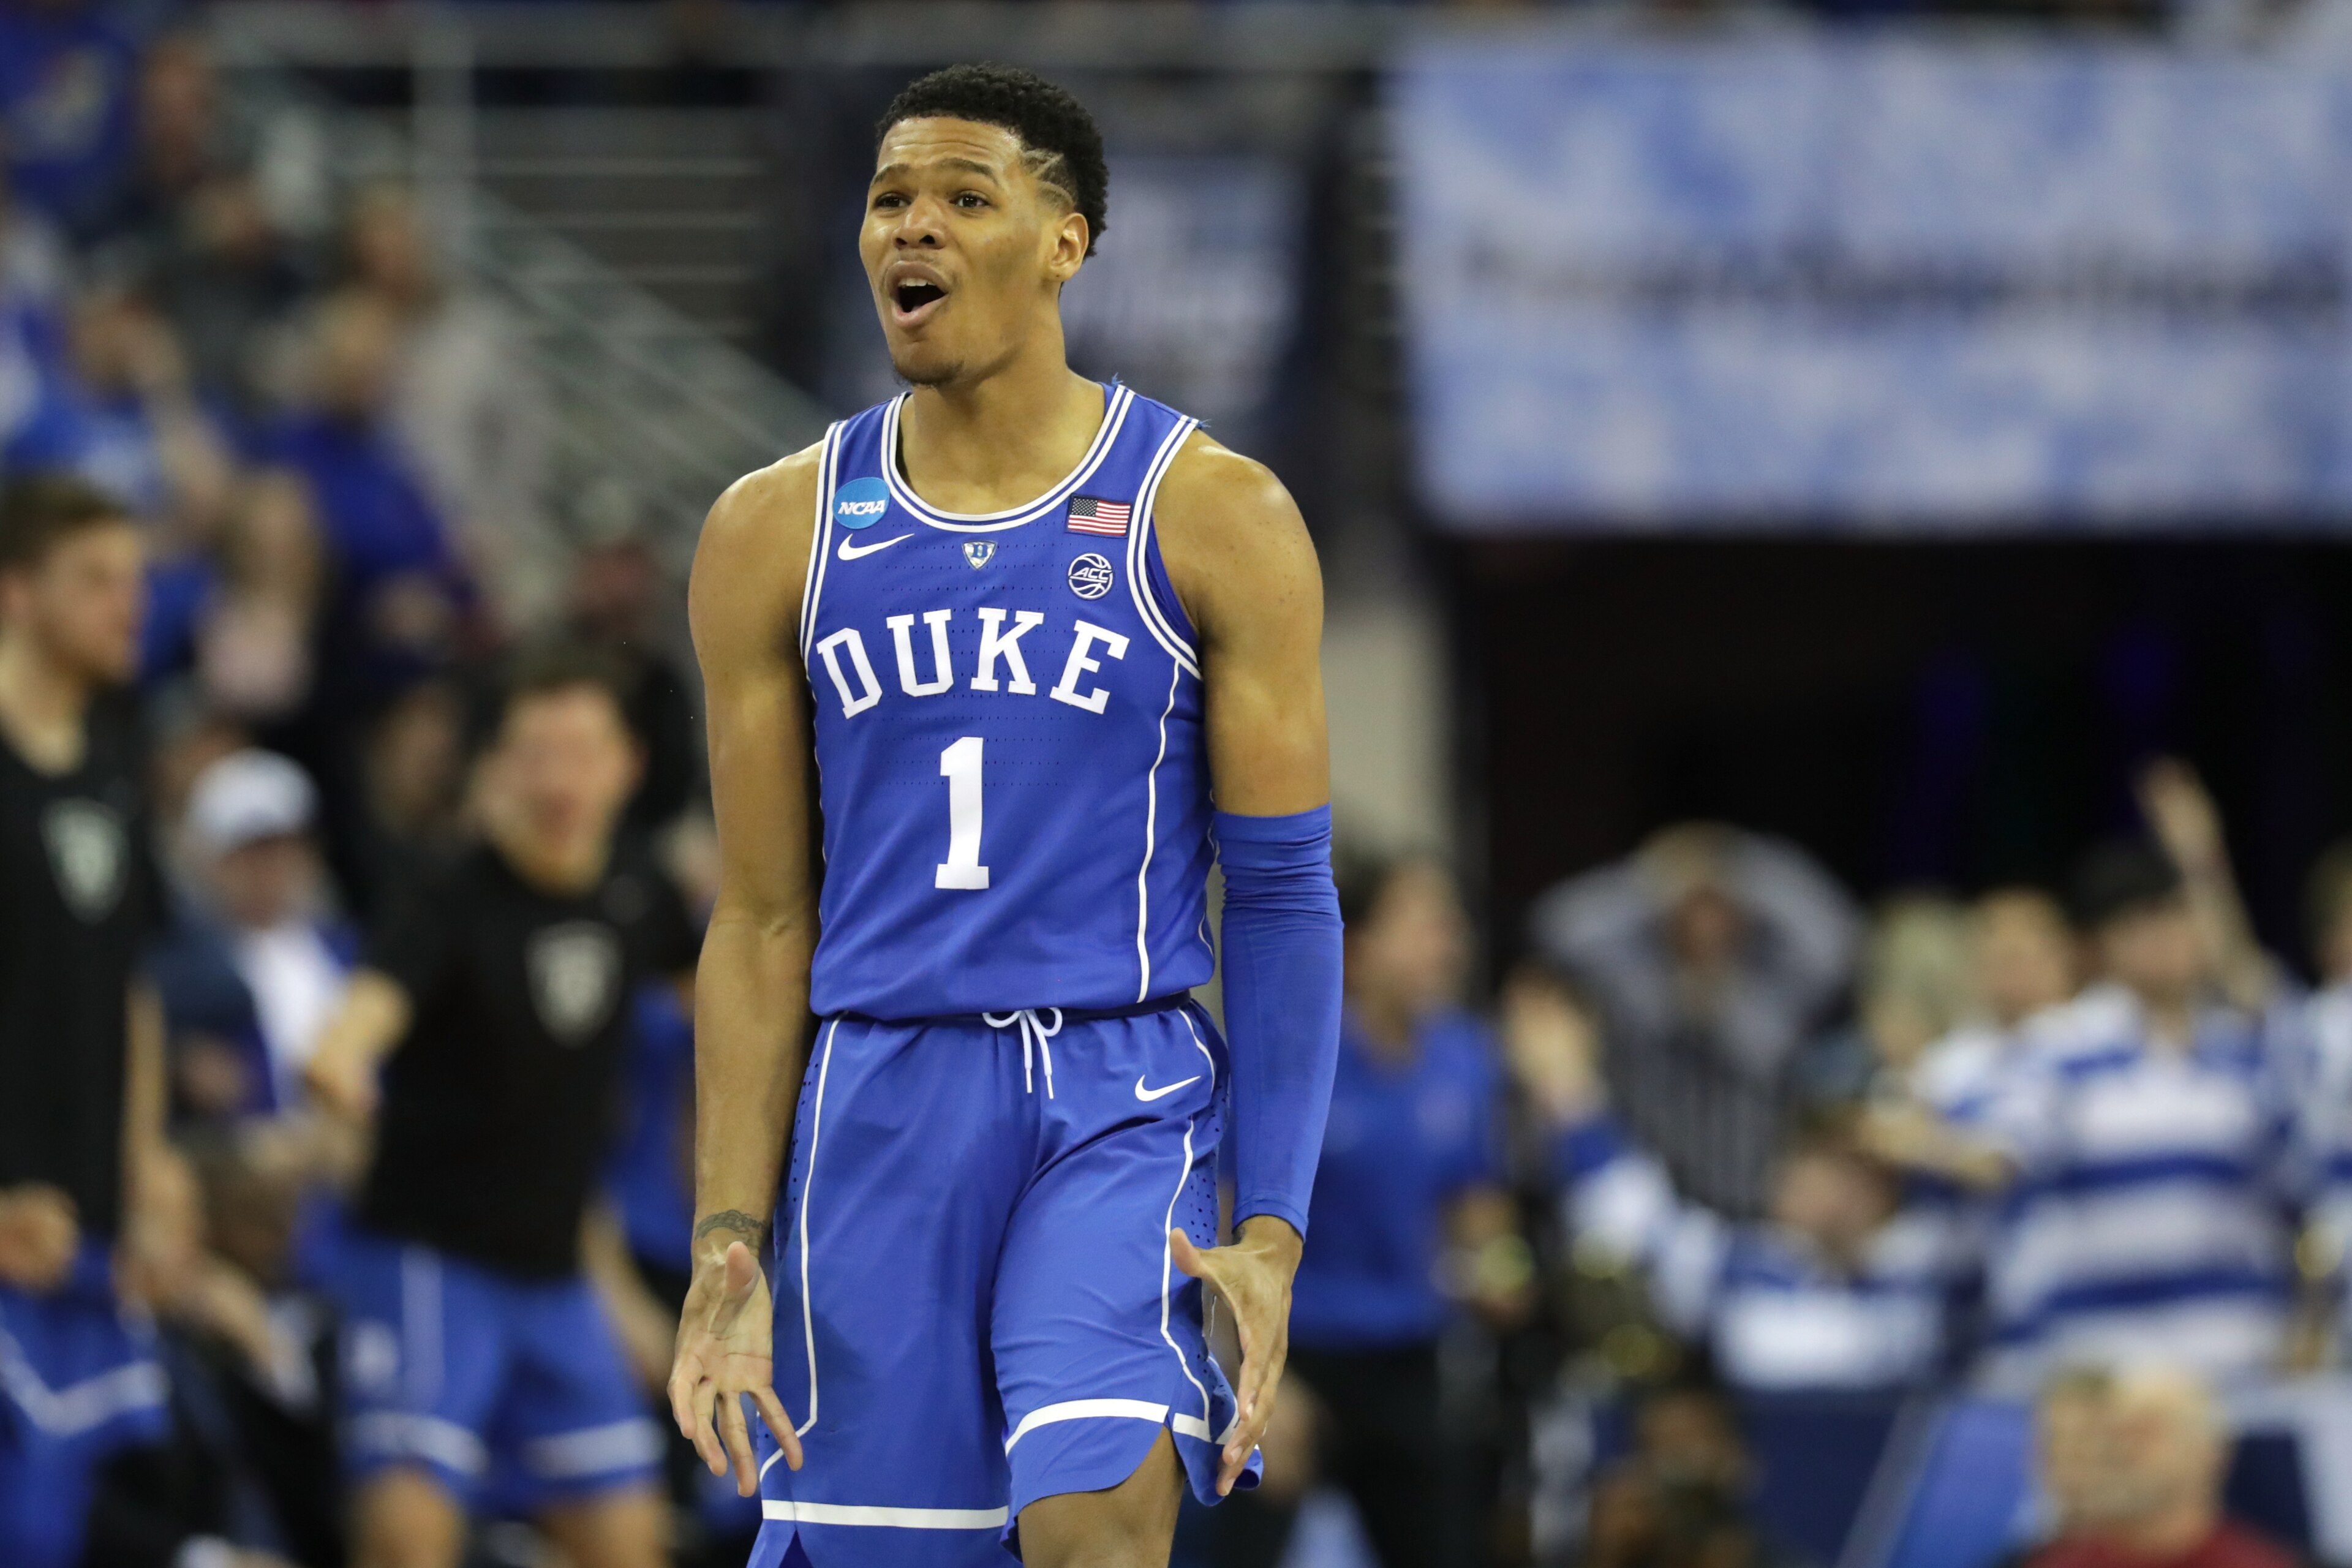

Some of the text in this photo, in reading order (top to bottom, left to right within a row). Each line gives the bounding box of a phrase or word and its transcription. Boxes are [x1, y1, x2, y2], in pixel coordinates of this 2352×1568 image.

[837, 499, 886, 515] NCAA
[1072, 567, 1112, 581] ACC
[816, 607, 1130, 719] DUKE
[935, 736, 990, 890] 1
